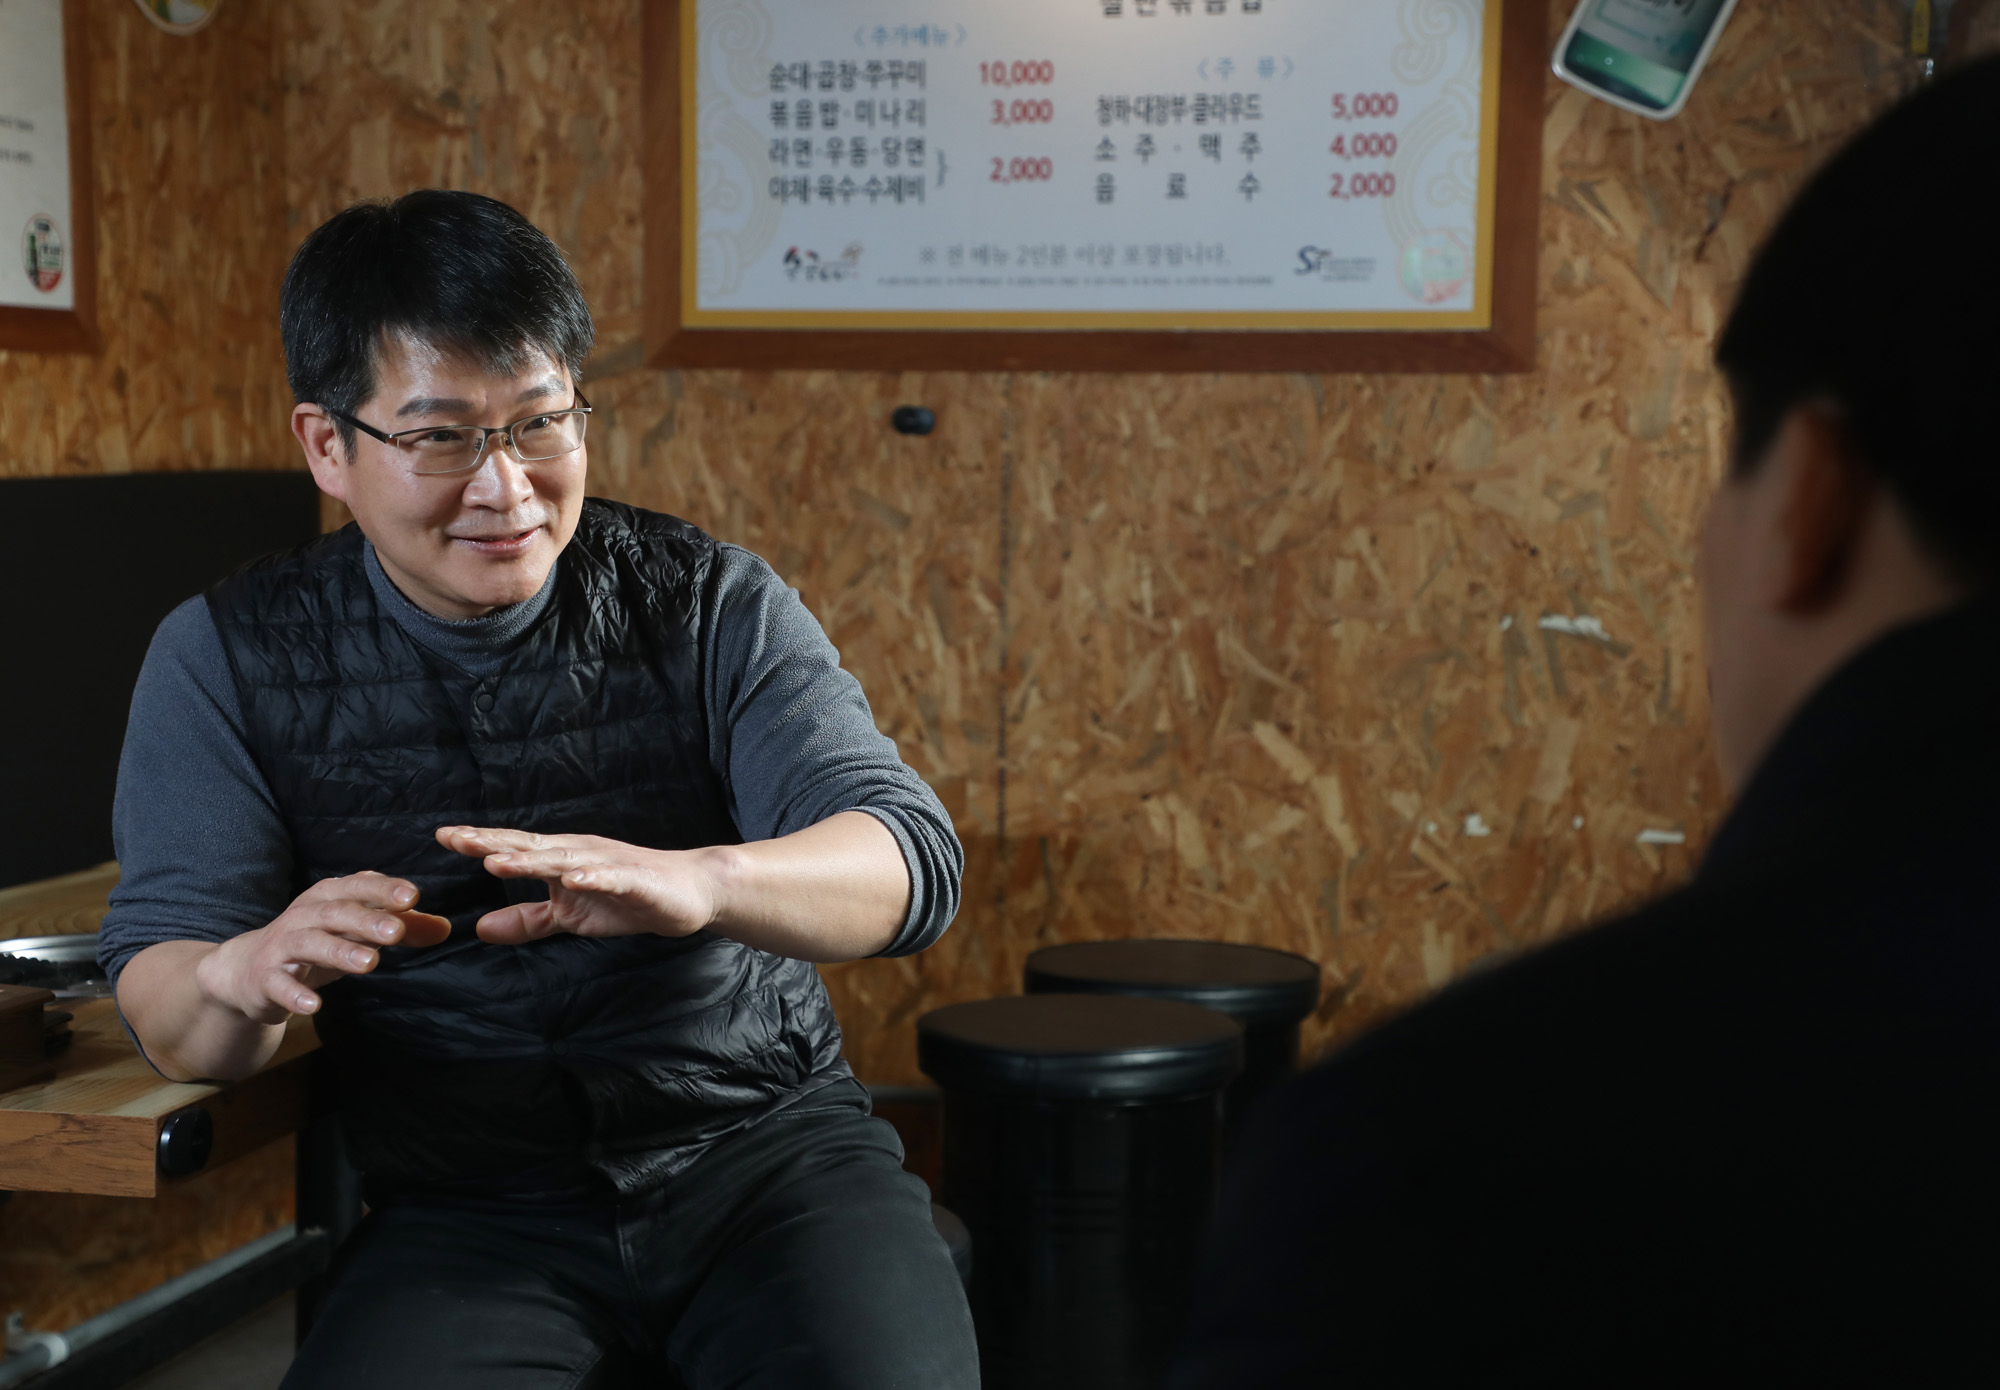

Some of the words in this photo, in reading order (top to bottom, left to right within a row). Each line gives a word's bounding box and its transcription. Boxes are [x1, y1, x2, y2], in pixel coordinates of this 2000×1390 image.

[979, 60, 1055, 88] 10,000
[990, 99, 1054, 126] 3,000
[1332, 92, 1399, 121] 5,000
[1330, 132, 1398, 161] 4,000
[989, 156, 1053, 184] 2,000
[1329, 172, 1396, 200] 2,000
